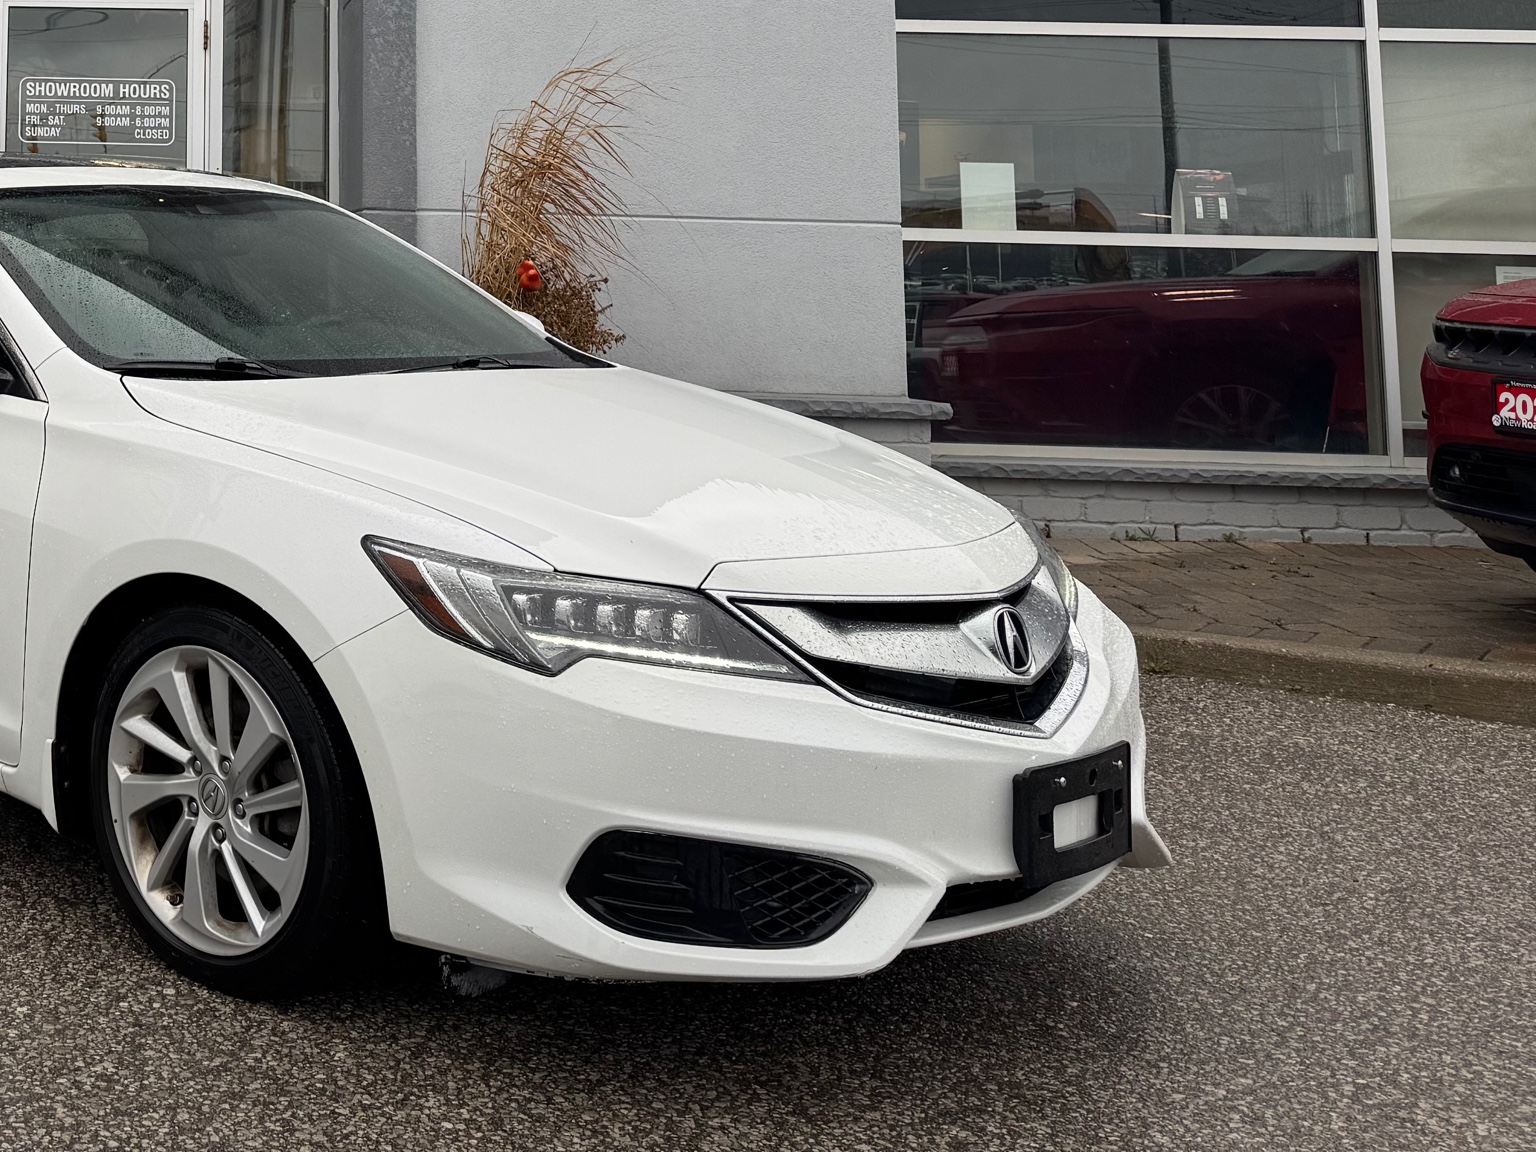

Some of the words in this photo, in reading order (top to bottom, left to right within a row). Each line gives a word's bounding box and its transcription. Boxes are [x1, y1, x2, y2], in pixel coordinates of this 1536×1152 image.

[26, 82, 114, 98] SHOWROOM
[119, 83, 170, 98] HOURS
[55, 104, 89, 115] THURS.
[48, 115, 66, 126] SAT.
[25, 127, 61, 137] SUNDAY
[134, 129, 170, 139] CLOSED
[1499, 392, 1536, 421] 20
